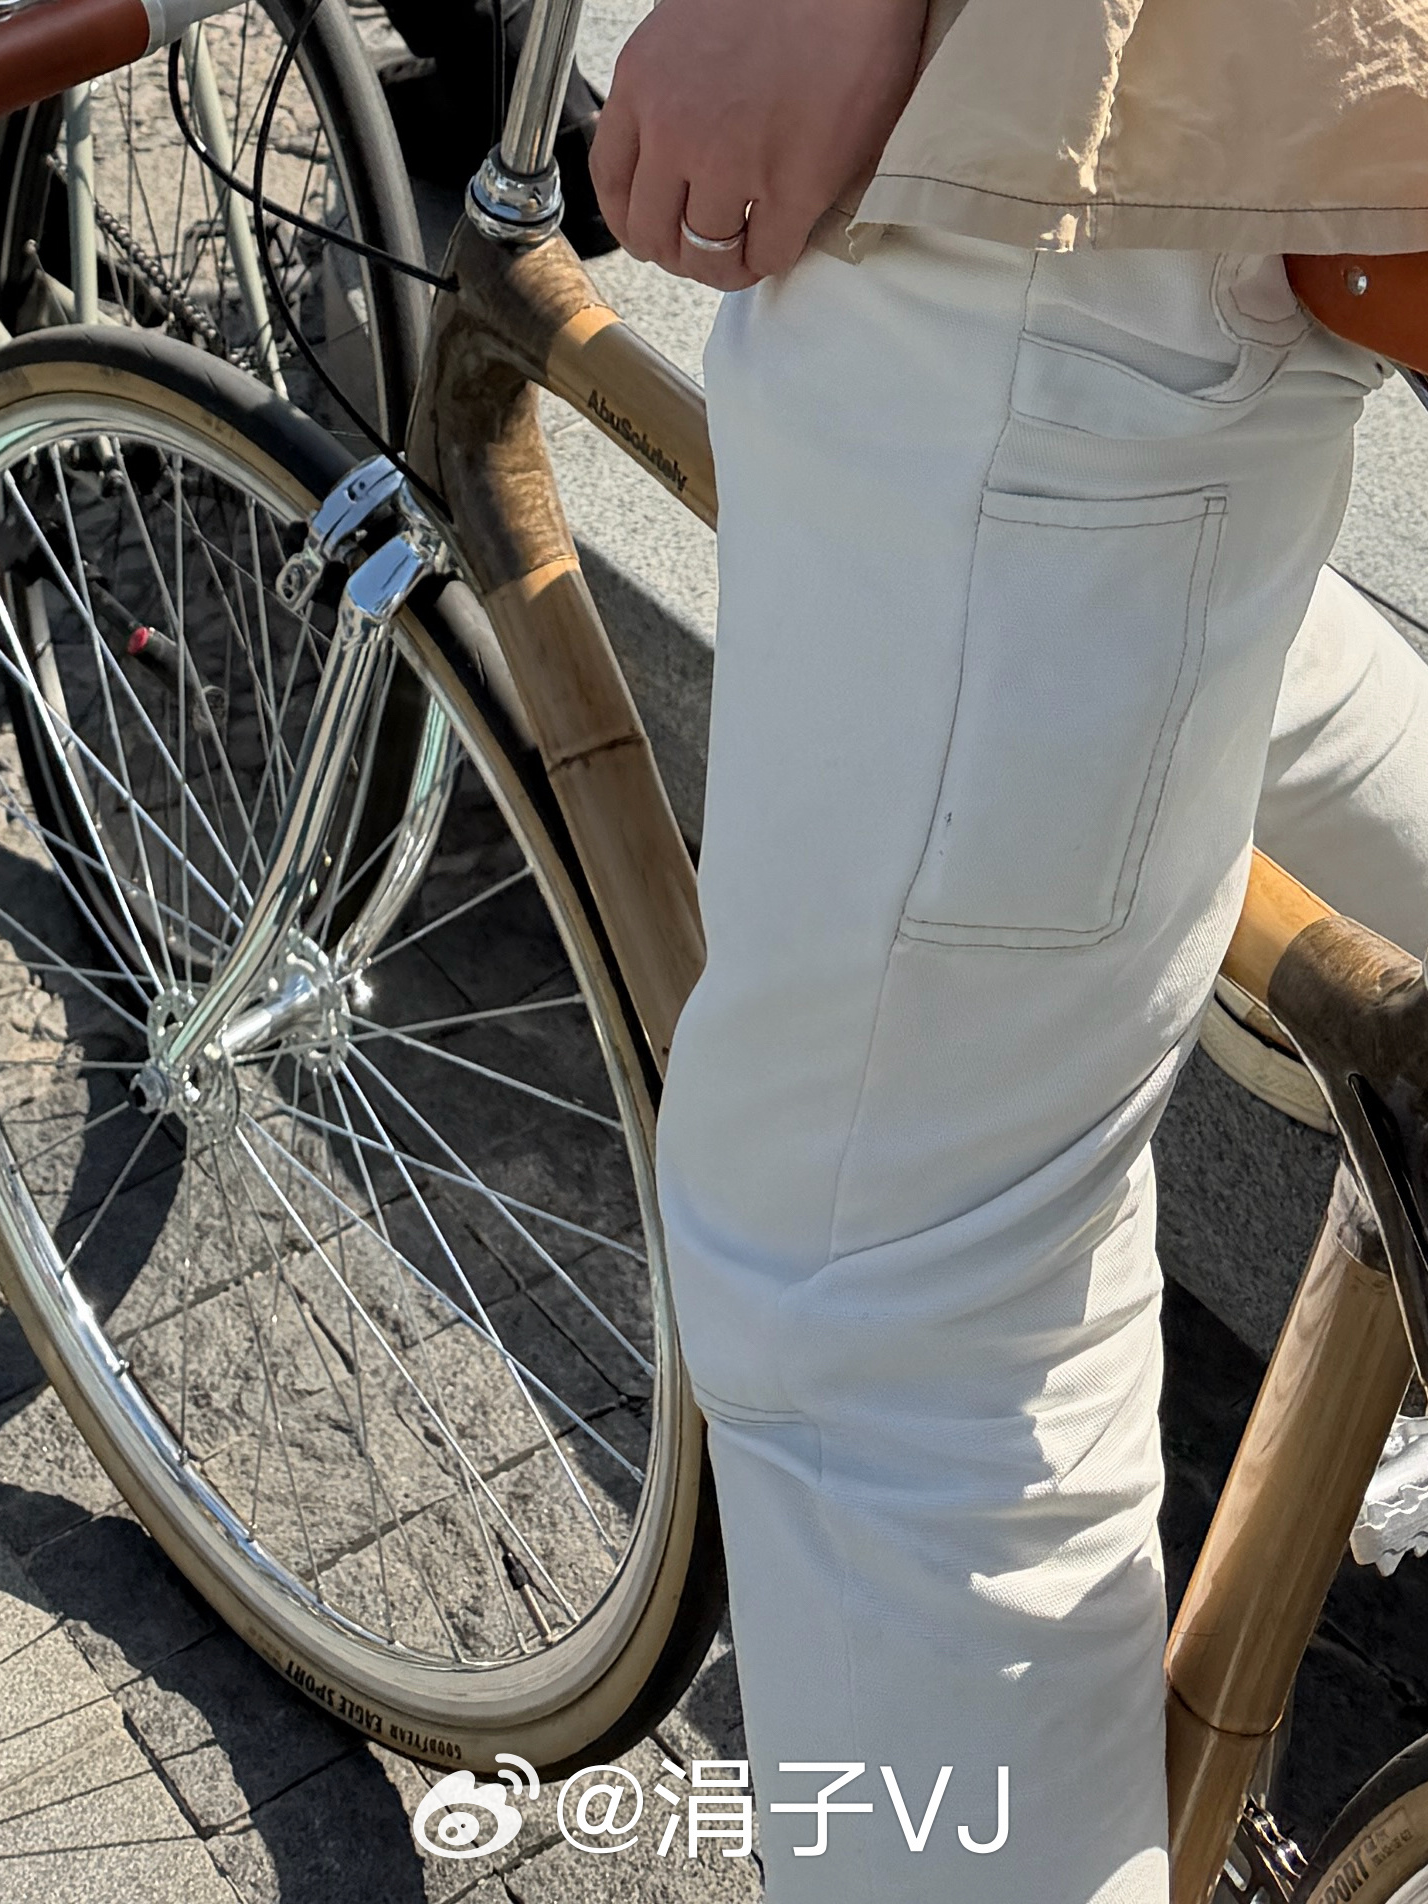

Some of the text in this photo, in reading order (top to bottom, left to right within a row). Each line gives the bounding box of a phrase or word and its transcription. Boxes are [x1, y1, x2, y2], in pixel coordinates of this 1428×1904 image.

[284, 1659, 337, 1708] SPORT
[339, 1694, 383, 1735] EAGLE
[1317, 1847, 1370, 1904] PORT
